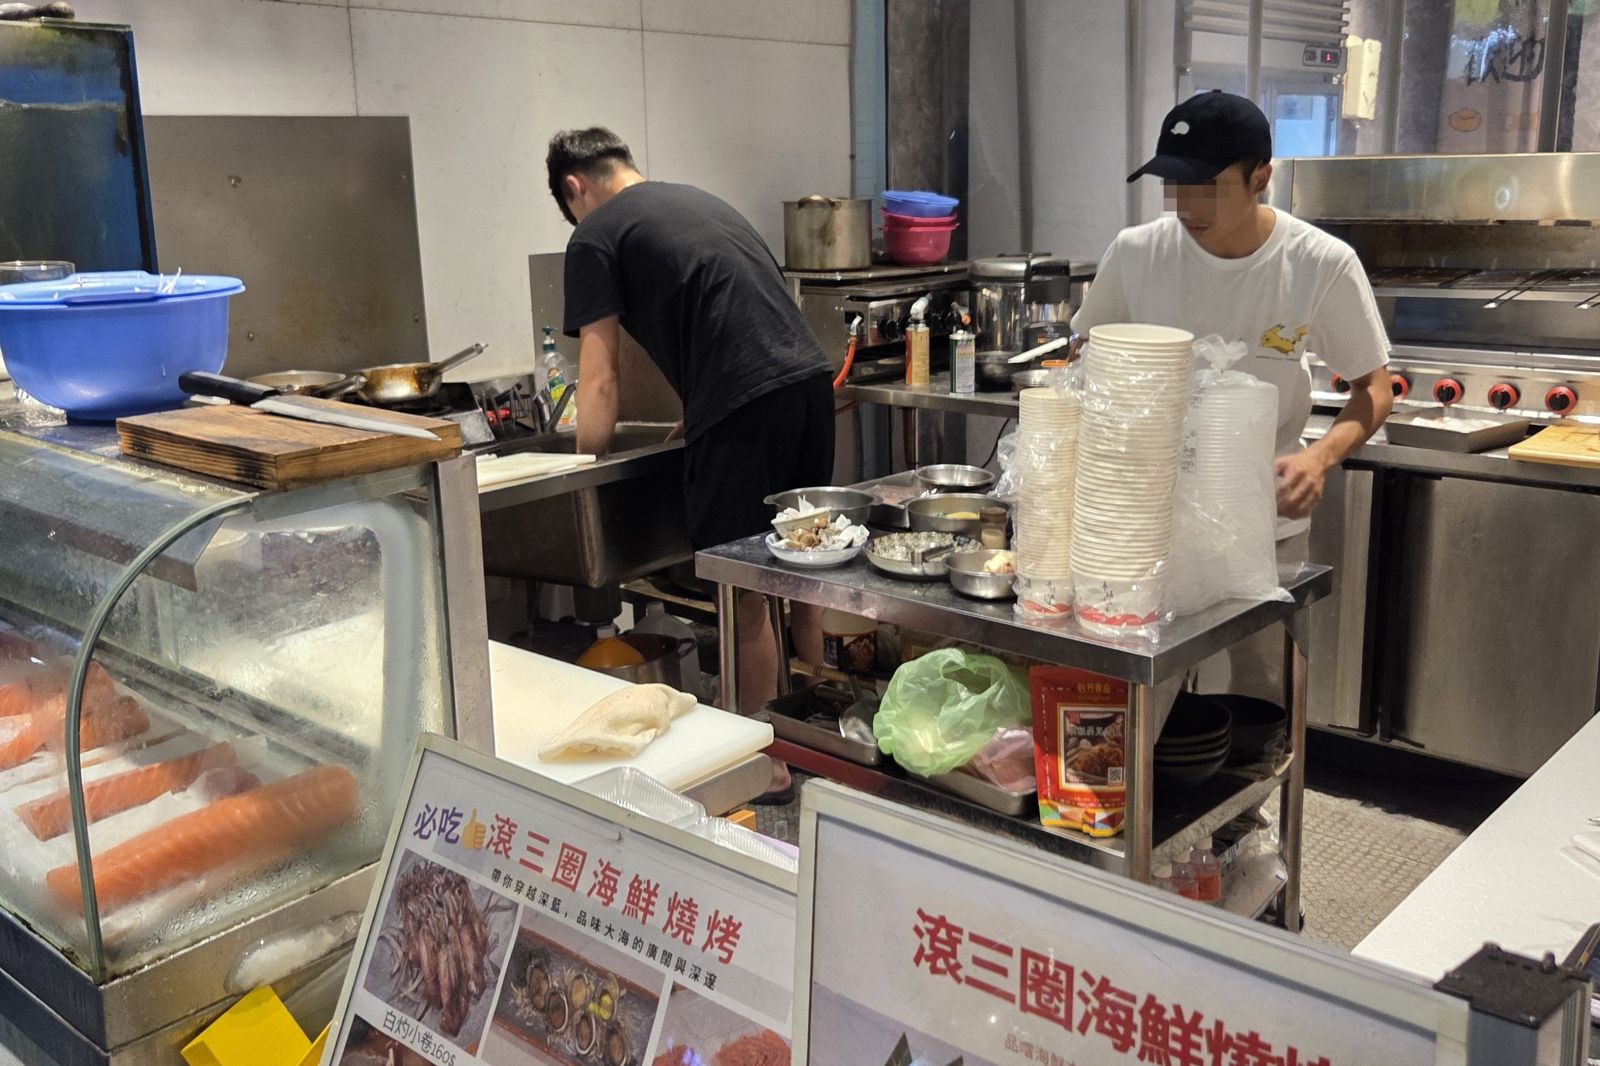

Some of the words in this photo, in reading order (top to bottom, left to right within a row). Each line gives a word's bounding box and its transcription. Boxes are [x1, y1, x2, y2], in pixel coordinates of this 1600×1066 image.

[413, 802, 463, 845] 必吃
[486, 814, 744, 965] 滾三圈海鮮燒烤
